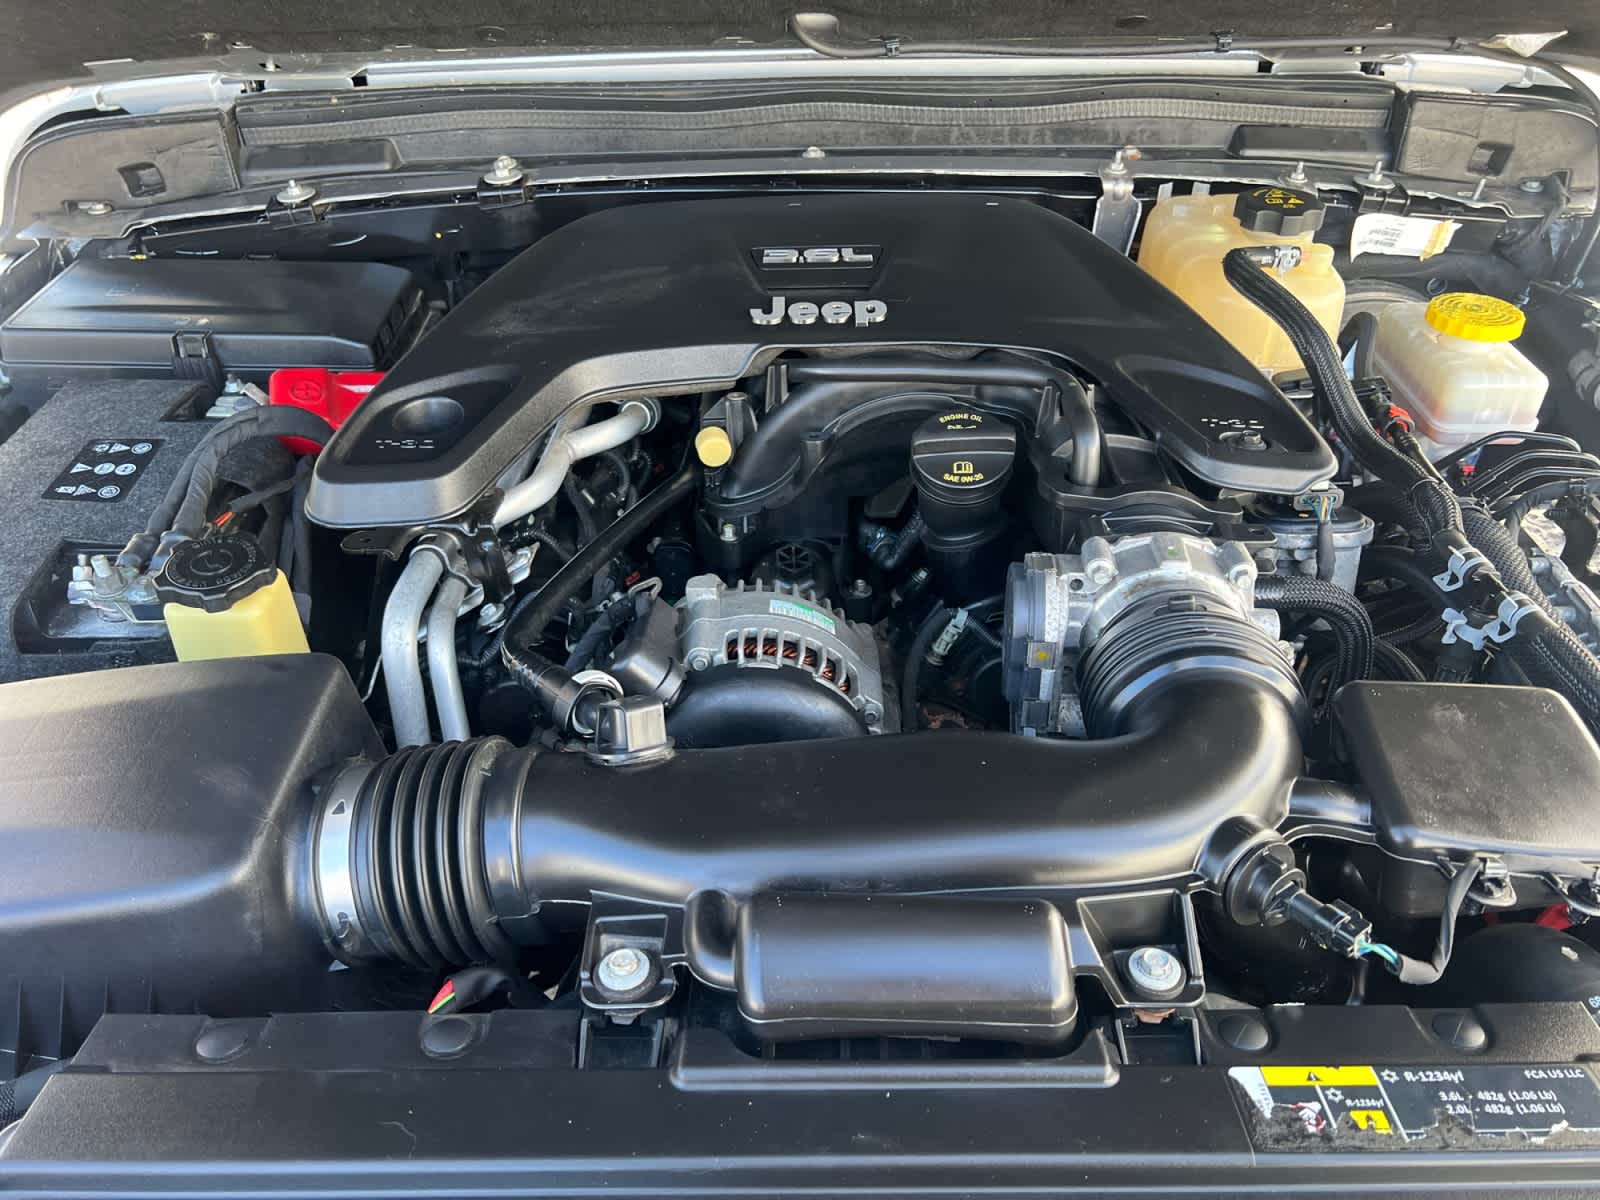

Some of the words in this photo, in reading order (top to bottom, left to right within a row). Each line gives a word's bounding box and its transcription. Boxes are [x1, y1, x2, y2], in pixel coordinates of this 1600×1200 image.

[763, 247, 874, 264] 3.6L
[749, 296, 888, 327] Jeep
[938, 413, 969, 424] ENGINE
[970, 414, 983, 424] OIL
[943, 473, 960, 483] SAE
[960, 472, 984, 483] 0W-20
[1524, 1069, 1548, 1080] FCA
[1549, 1069, 1565, 1079] US
[1565, 1069, 1585, 1079] LLC
[1438, 1091, 1465, 1101] 3.6L
[1477, 1091, 1506, 1102] 482g
[1446, 1104, 1472, 1114] 2.0L
[1484, 1104, 1514, 1115] 482g
